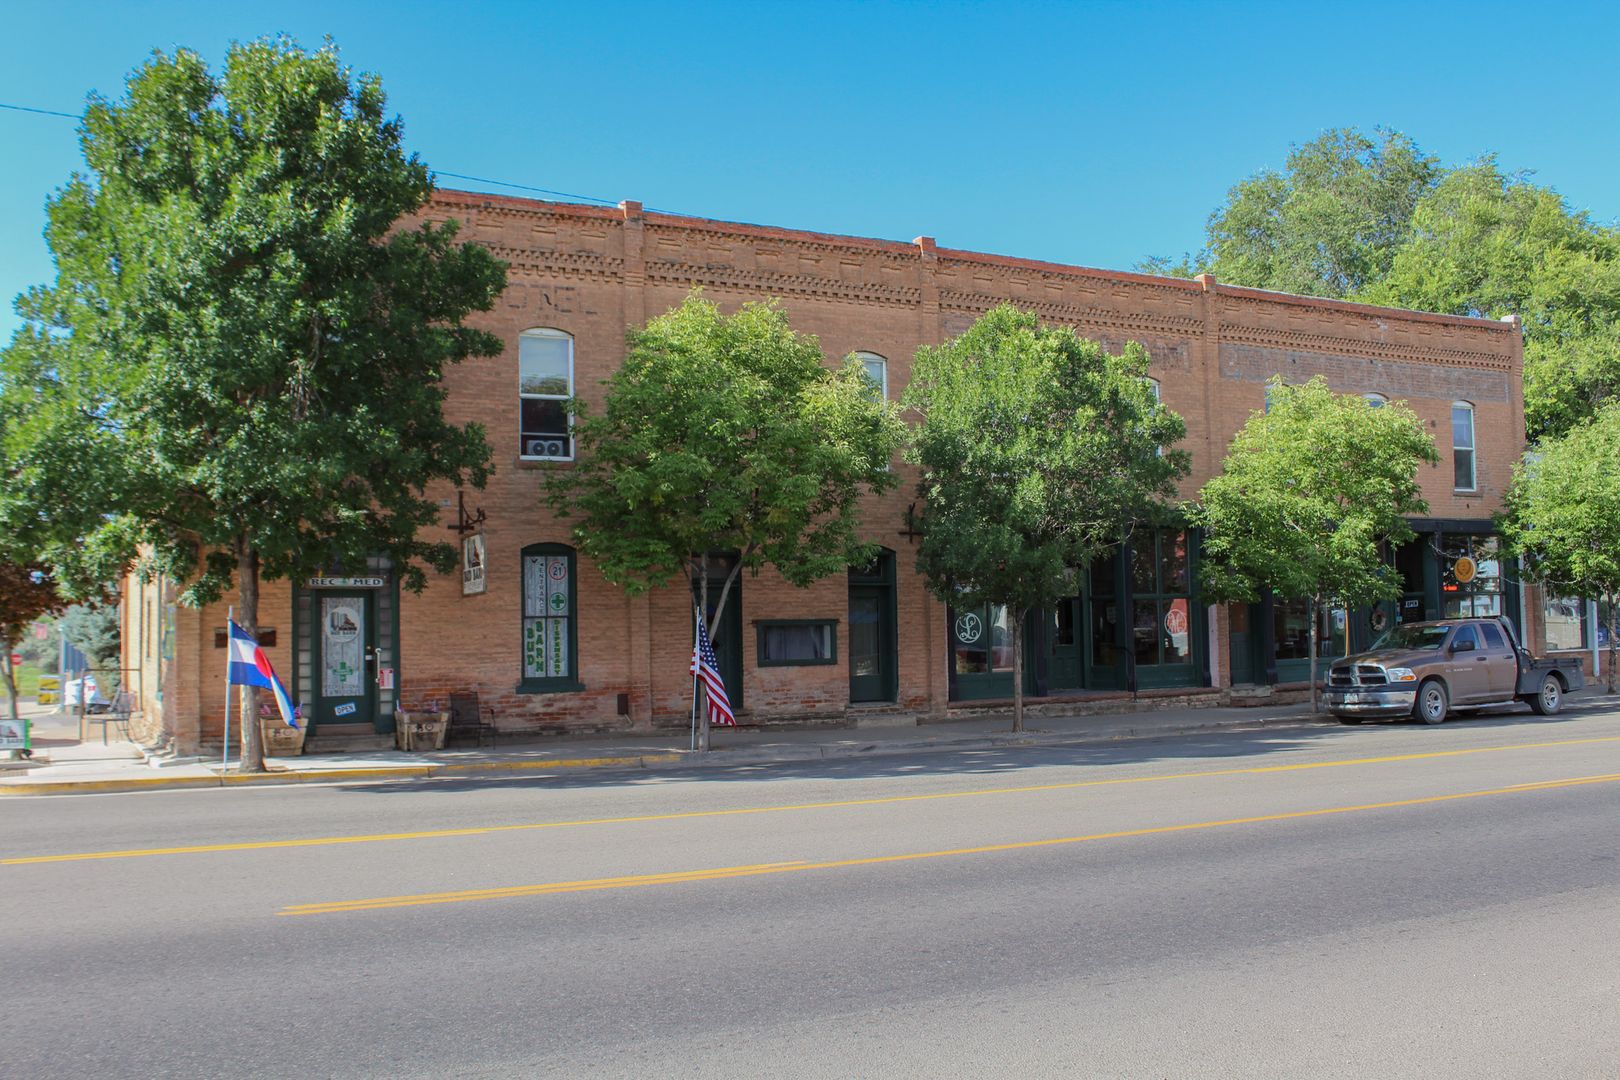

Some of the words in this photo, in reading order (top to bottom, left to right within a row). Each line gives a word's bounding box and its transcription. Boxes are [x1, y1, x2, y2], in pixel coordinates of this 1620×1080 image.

[311, 578, 336, 586] REC
[353, 578, 381, 586] MED
[336, 705, 354, 714] OPEN
